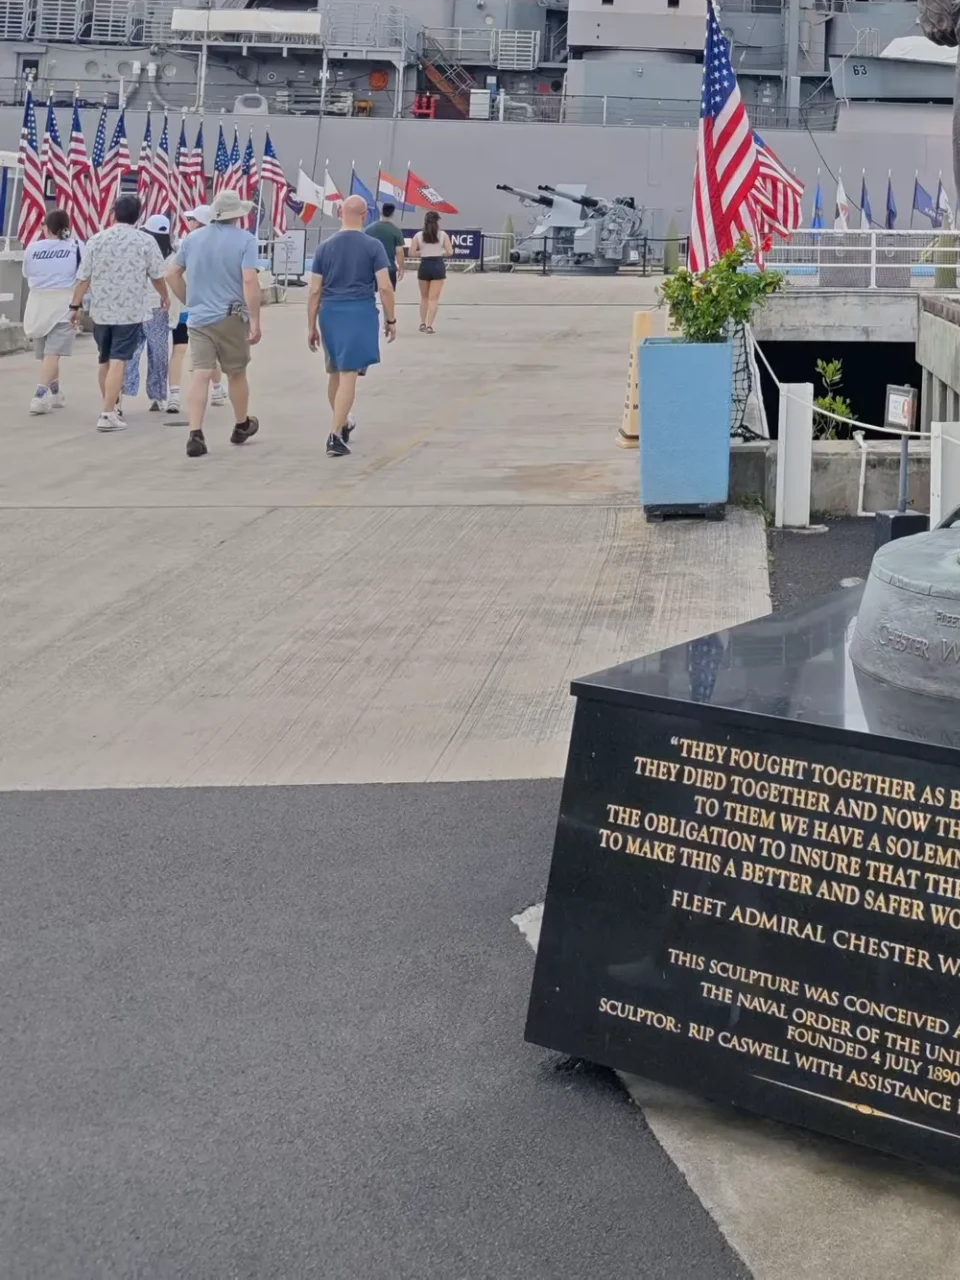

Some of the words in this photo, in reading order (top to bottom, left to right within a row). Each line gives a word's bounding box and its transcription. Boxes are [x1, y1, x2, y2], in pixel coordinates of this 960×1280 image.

[852, 64, 867, 76] 63
[451, 235, 473, 246] NCE
[634, 756, 679, 781] THEY
[683, 767, 727, 792] DIED
[731, 776, 831, 813] TOGETHER
[833, 798, 877, 821] AND
[882, 806, 932, 832] NOW
[730, 750, 807, 780] FOUGHT
[812, 763, 916, 802] TOGETHER
[920, 784, 946, 806] AS
[606, 804, 641, 828] THE
[644, 812, 755, 853] OBLIGATION
[760, 837, 786, 859] TO
[790, 844, 861, 877] INSURE
[866, 860, 921, 890] THAT
[694, 795, 719, 817] TO
[724, 801, 776, 830] THEM
[780, 813, 809, 837] WE
[813, 821, 864, 849] HAVE
[867, 832, 882, 853] A
[599, 828, 623, 851] TO
[626, 837, 676, 864] MAKE
[680, 847, 721, 874] THIS
[723, 858, 736, 877] A
[741, 861, 813, 895] BETTER
[816, 879, 861, 906] AND
[864, 889, 924, 922] SAFER
[671, 890, 726, 919] FLEET
[729, 905, 826, 944] ADMIRAL
[832, 930, 933, 972] CHESTER
[668, 948, 705, 971] THIS
[708, 960, 799, 996] SCULPTURE
[804, 984, 839, 1007] WAS
[844, 995, 949, 1035] CONCEIVED
[700, 982, 732, 1003] THE
[736, 992, 788, 1019] NAVAL
[792, 1007, 852, 1038] ORDER
[856, 1025, 880, 1043] OF
[884, 1032, 921, 1056] THE
[599, 997, 681, 1033] SCULPTOR:
[688, 1023, 714, 1042] RIP
[718, 1031, 790, 1065] CASWELL
[794, 1052, 843, 1081] WITH
[846, 1070, 951, 1111] ASSISTANCE
[787, 1025, 867, 1060] FOUNDED
[871, 1050, 881, 1065] 4
[883, 1054, 922, 1077] JULY
[927, 1065, 960, 1086] 1890
